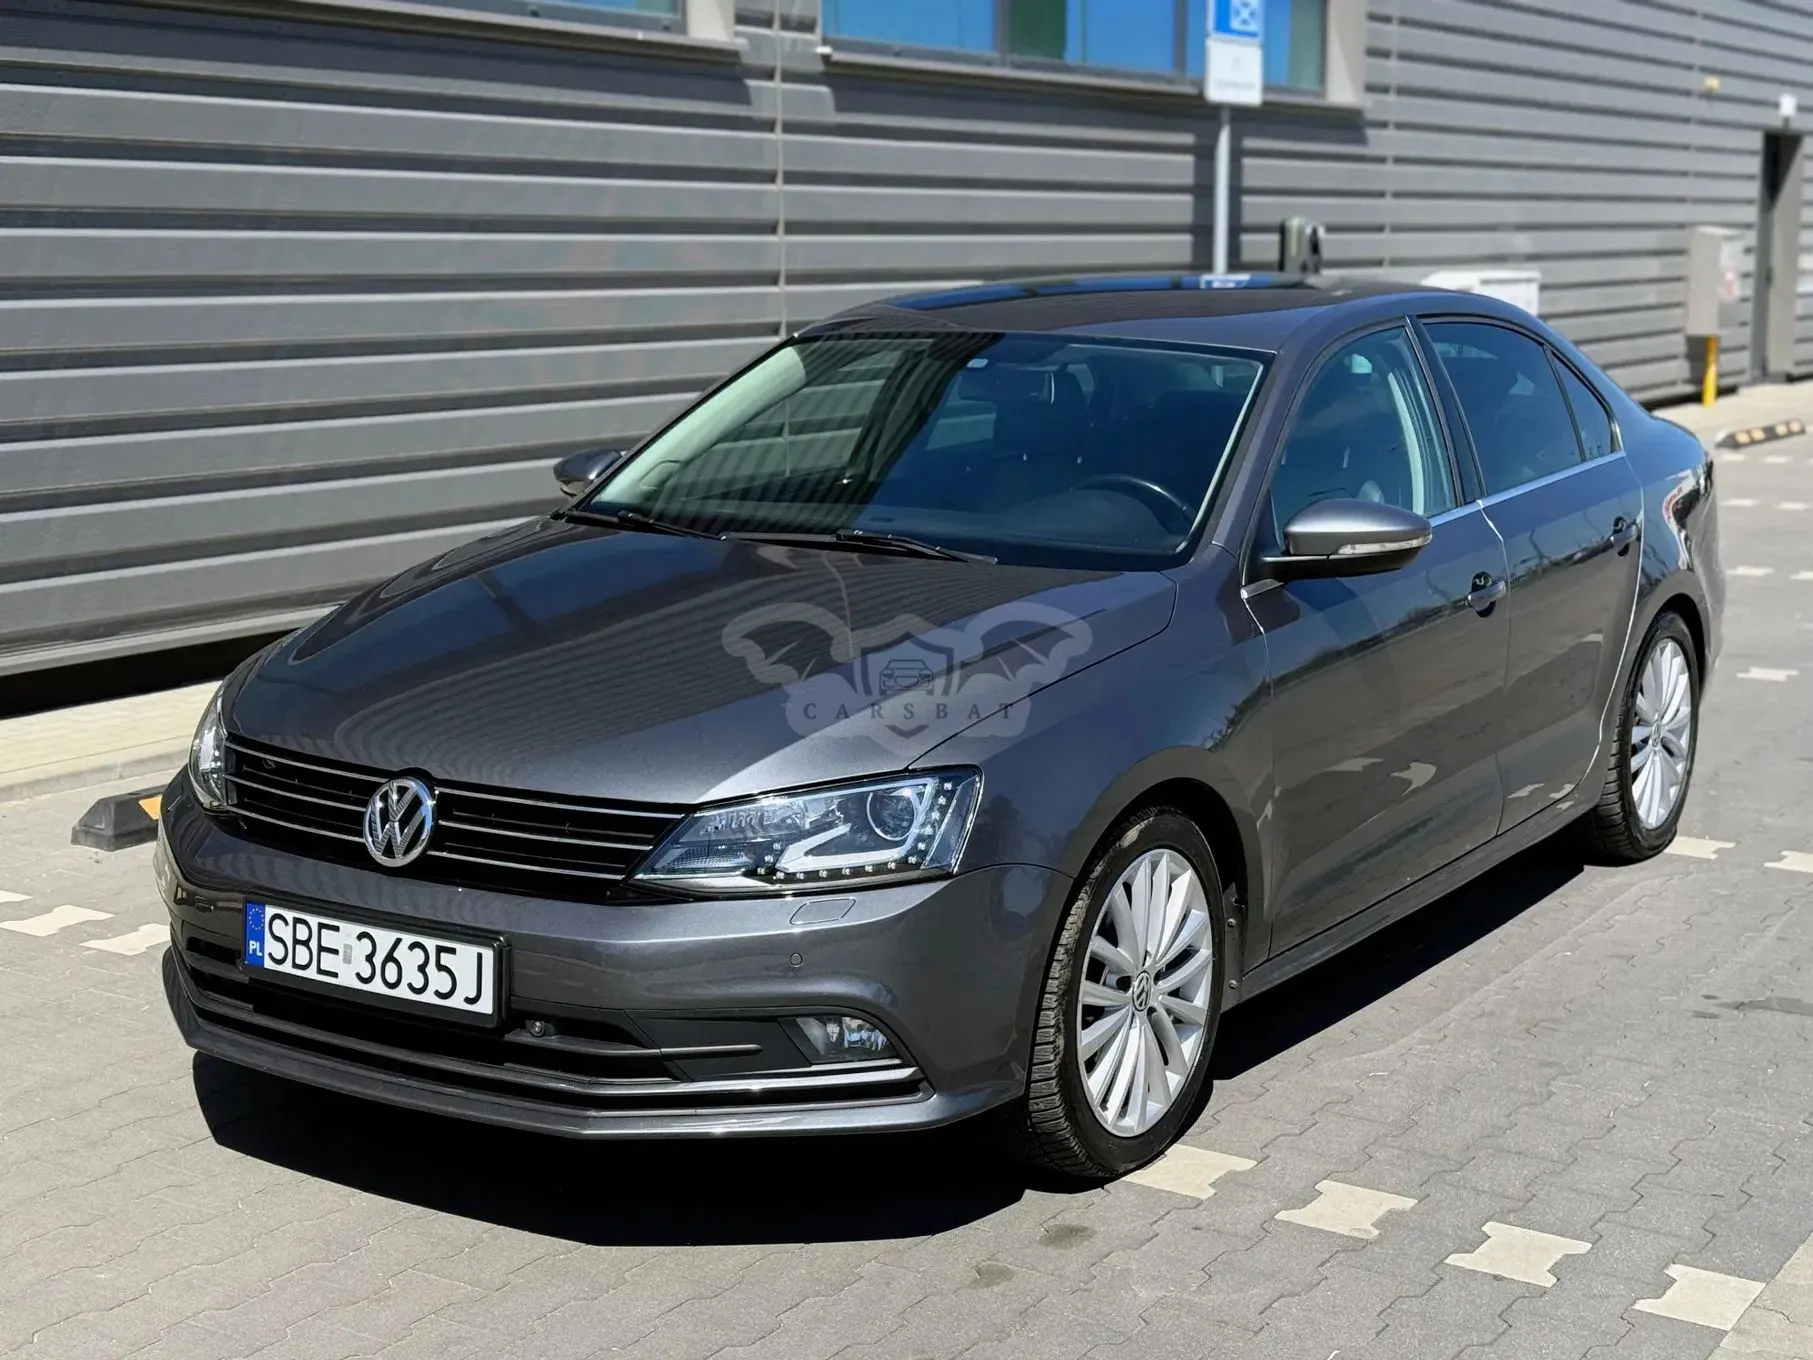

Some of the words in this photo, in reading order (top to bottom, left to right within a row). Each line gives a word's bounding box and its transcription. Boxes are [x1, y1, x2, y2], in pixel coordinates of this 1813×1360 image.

[364, 777, 432, 866] VW
[249, 940, 263, 957] PL
[268, 913, 340, 979] SBE
[355, 931, 483, 1005] 3635J
